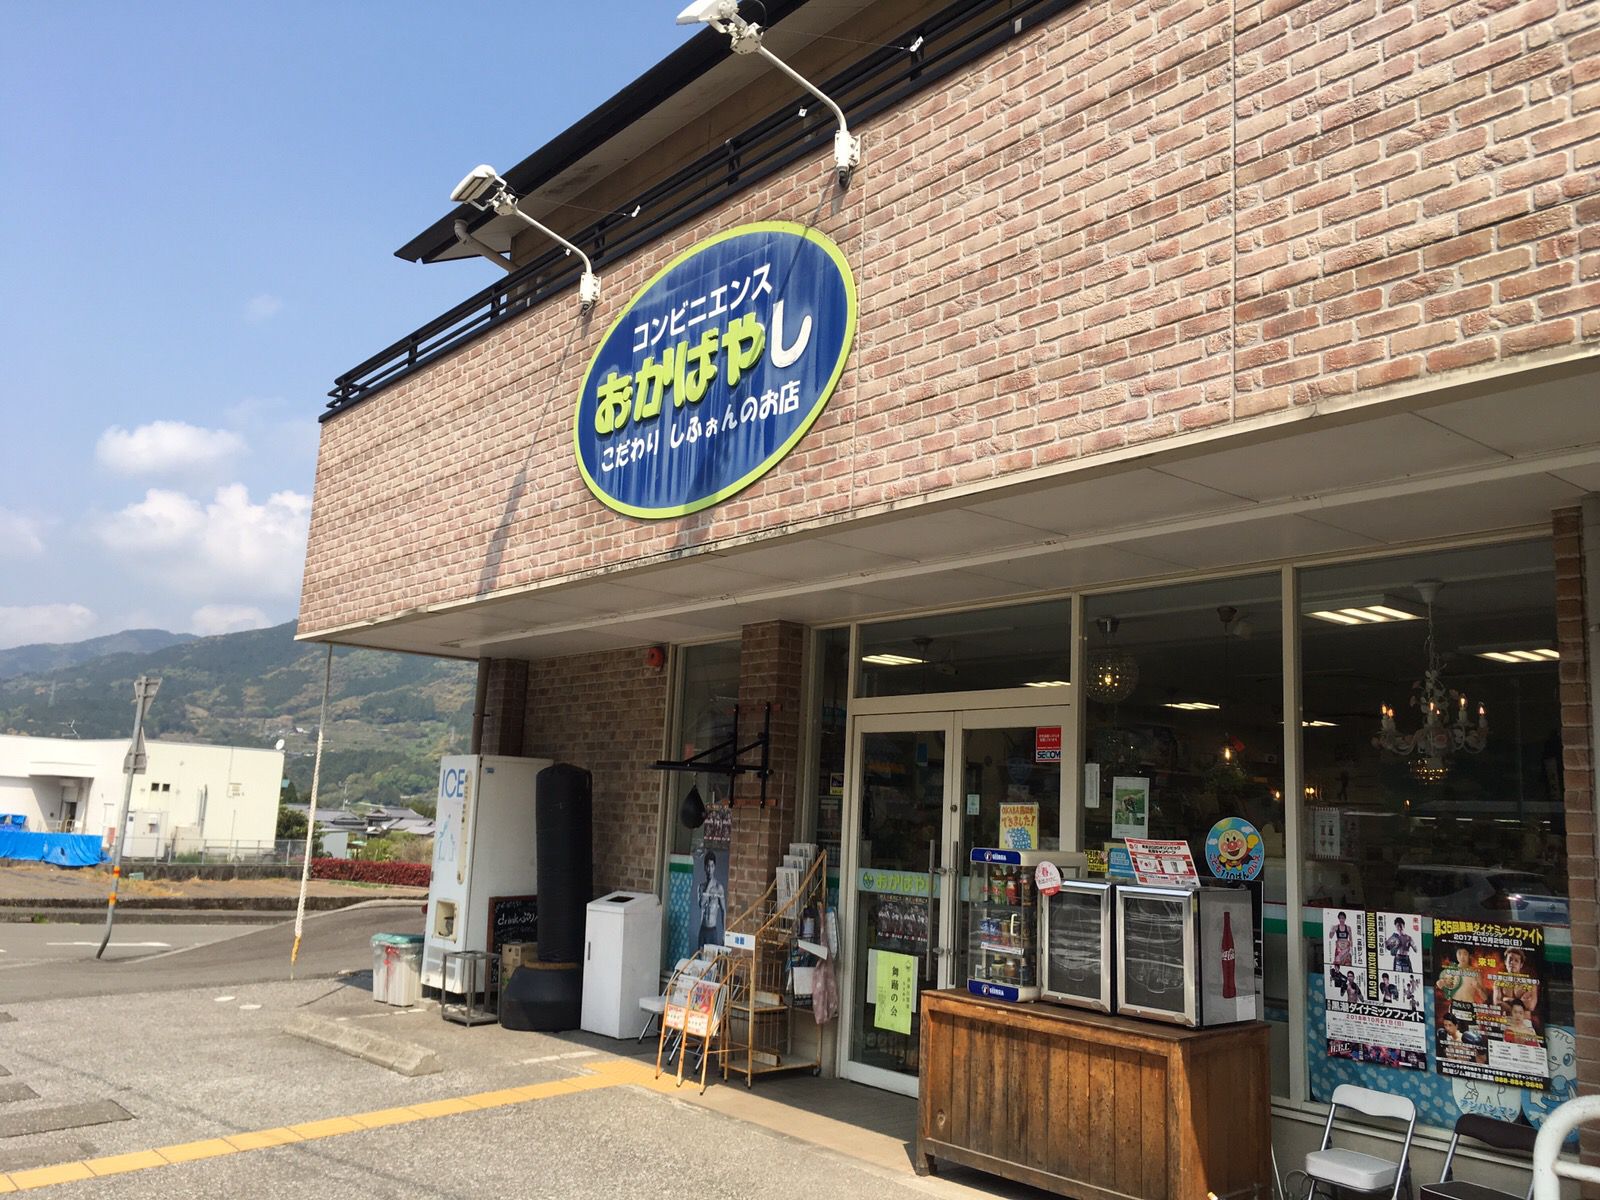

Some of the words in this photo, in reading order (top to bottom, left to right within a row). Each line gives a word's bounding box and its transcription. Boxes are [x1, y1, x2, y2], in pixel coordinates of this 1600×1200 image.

[632, 263, 774, 353] コンビニエンス
[594, 299, 813, 435] おかばやし
[601, 430, 660, 472] こだわり
[669, 380, 801, 450] しふぉんのお店
[1037, 750, 1062, 759] SECOM
[441, 768, 466, 799] ICE
[1366, 912, 1376, 949] KUROSHIO
[1367, 952, 1377, 982] BOXING
[1368, 982, 1377, 998] GYM
